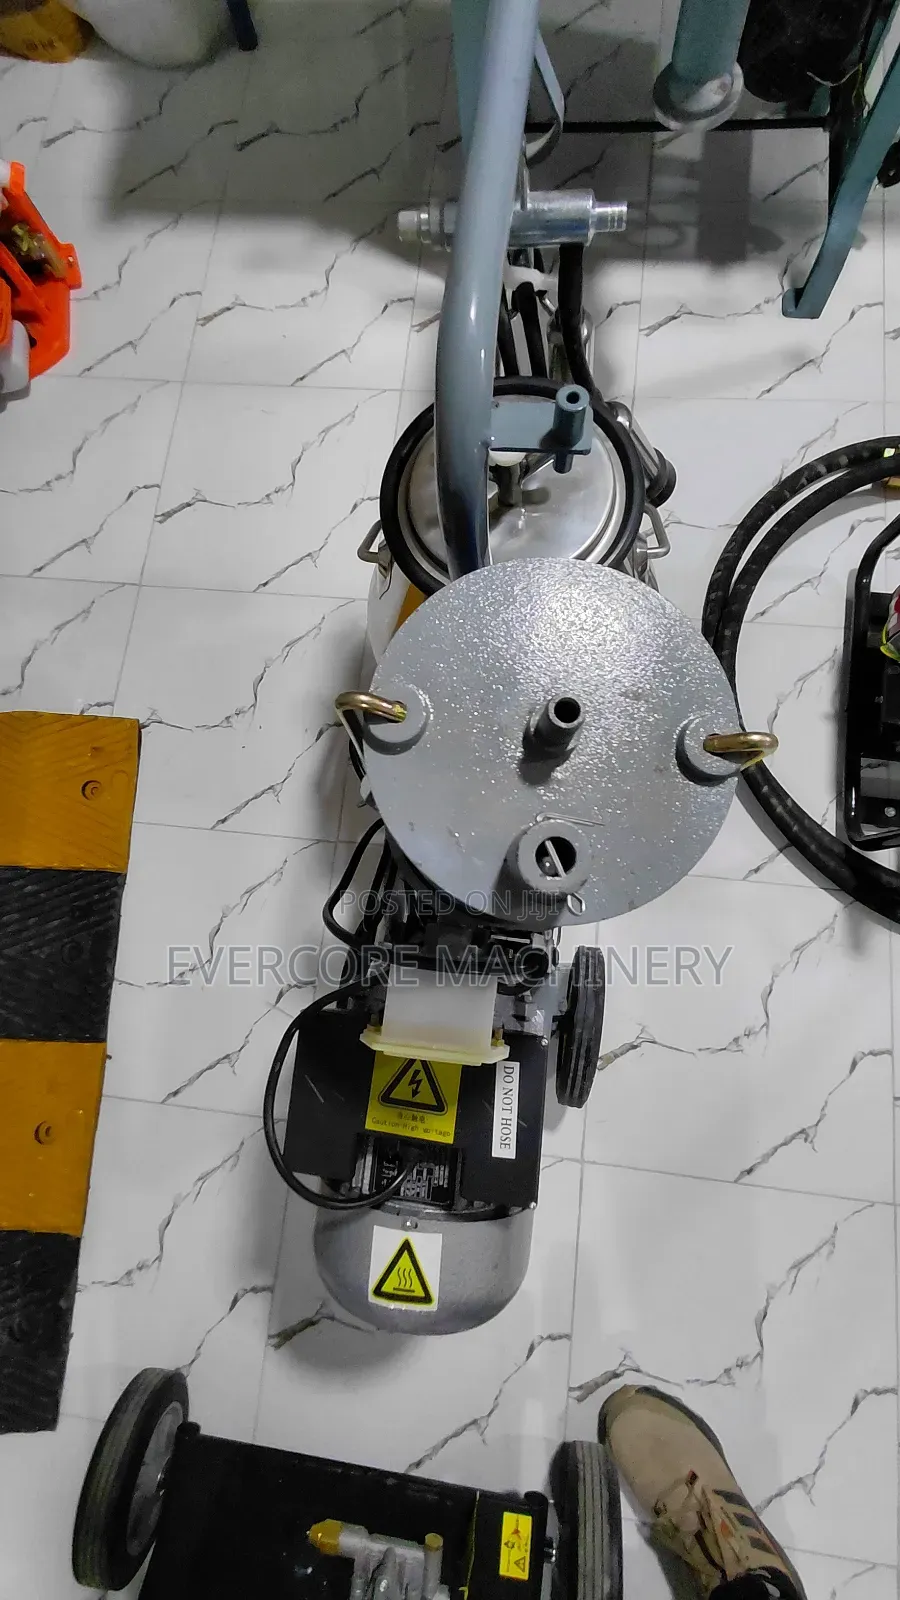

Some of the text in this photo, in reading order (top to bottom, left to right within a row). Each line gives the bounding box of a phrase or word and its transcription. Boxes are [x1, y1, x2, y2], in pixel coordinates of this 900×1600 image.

[500, 1066, 515, 1149] DO NOT HOSE
